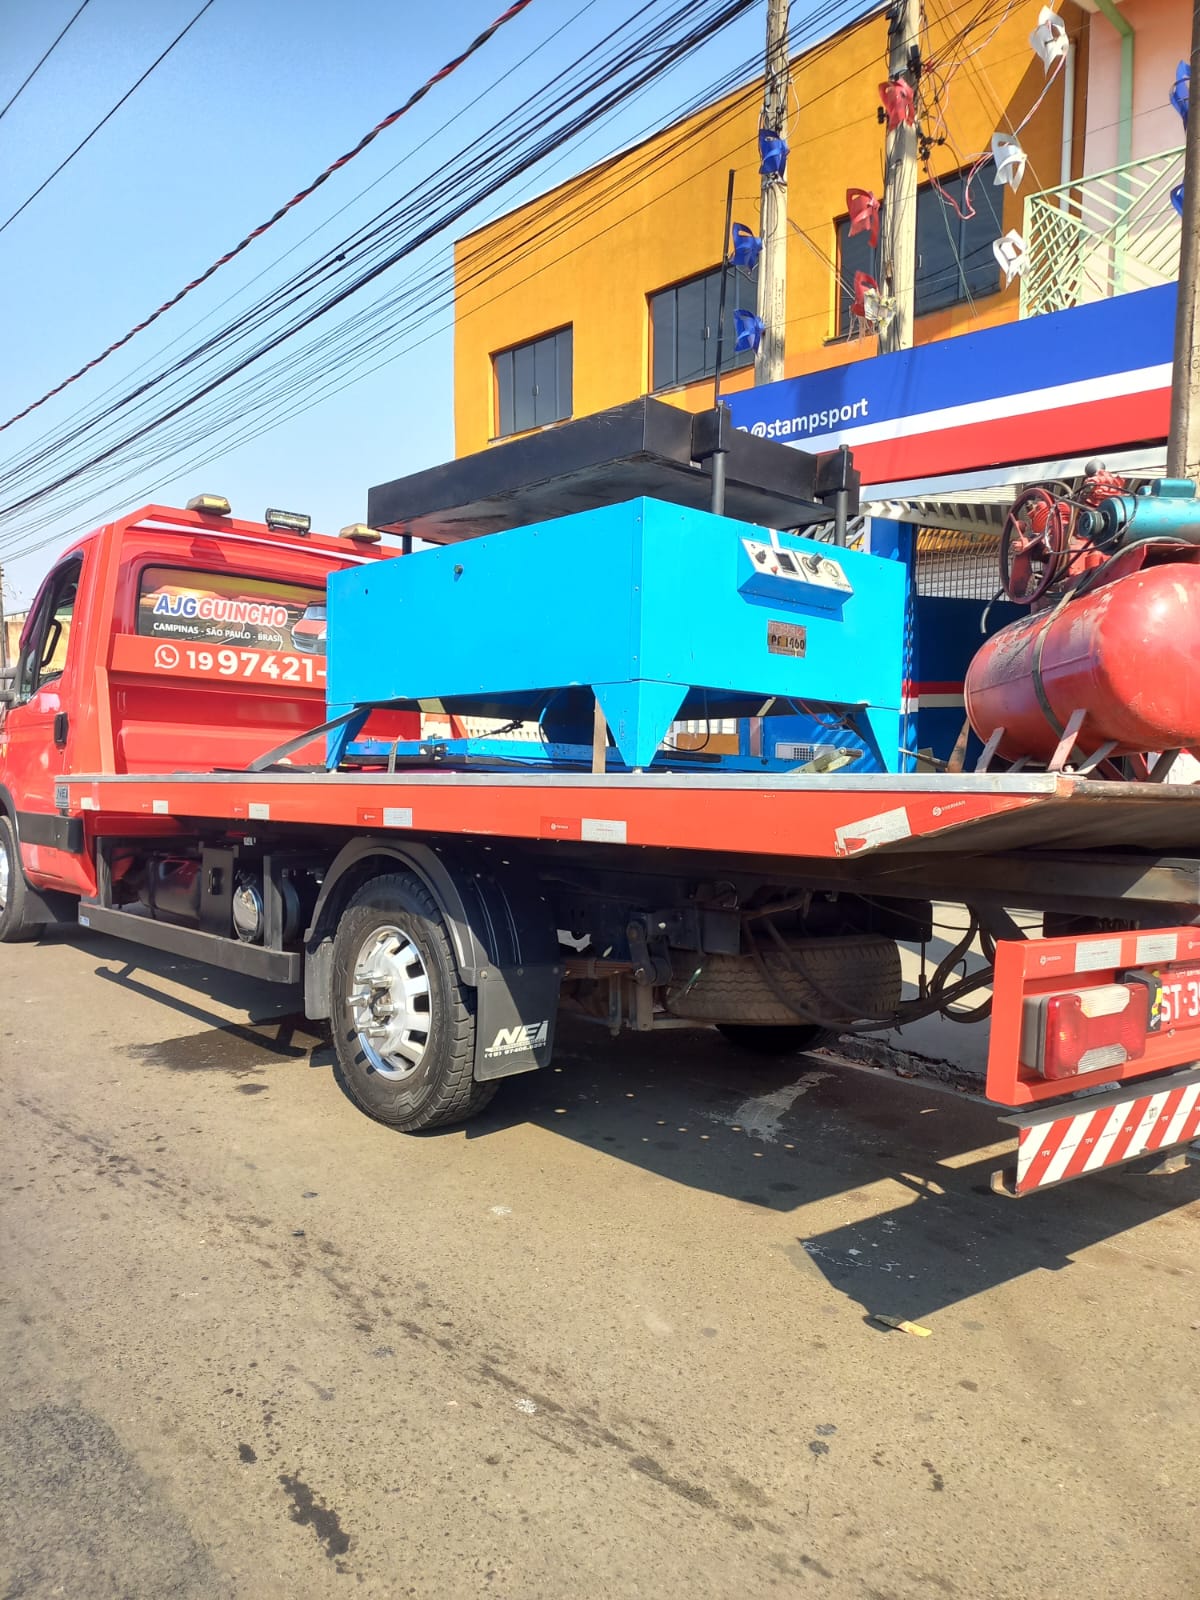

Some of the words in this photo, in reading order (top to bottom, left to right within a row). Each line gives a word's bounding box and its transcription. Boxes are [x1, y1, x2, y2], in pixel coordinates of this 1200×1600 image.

[751, 398, 868, 438] @stampsport
[154, 593, 197, 617] AJG
[198, 598, 288, 627] GUINCHO
[153, 622, 199, 634] CAMPINAS
[206, 627, 223, 637] SÃO
[224, 631, 250, 639] PAULO
[257, 633, 284, 643] BRASIL
[186, 650, 213, 670] 19
